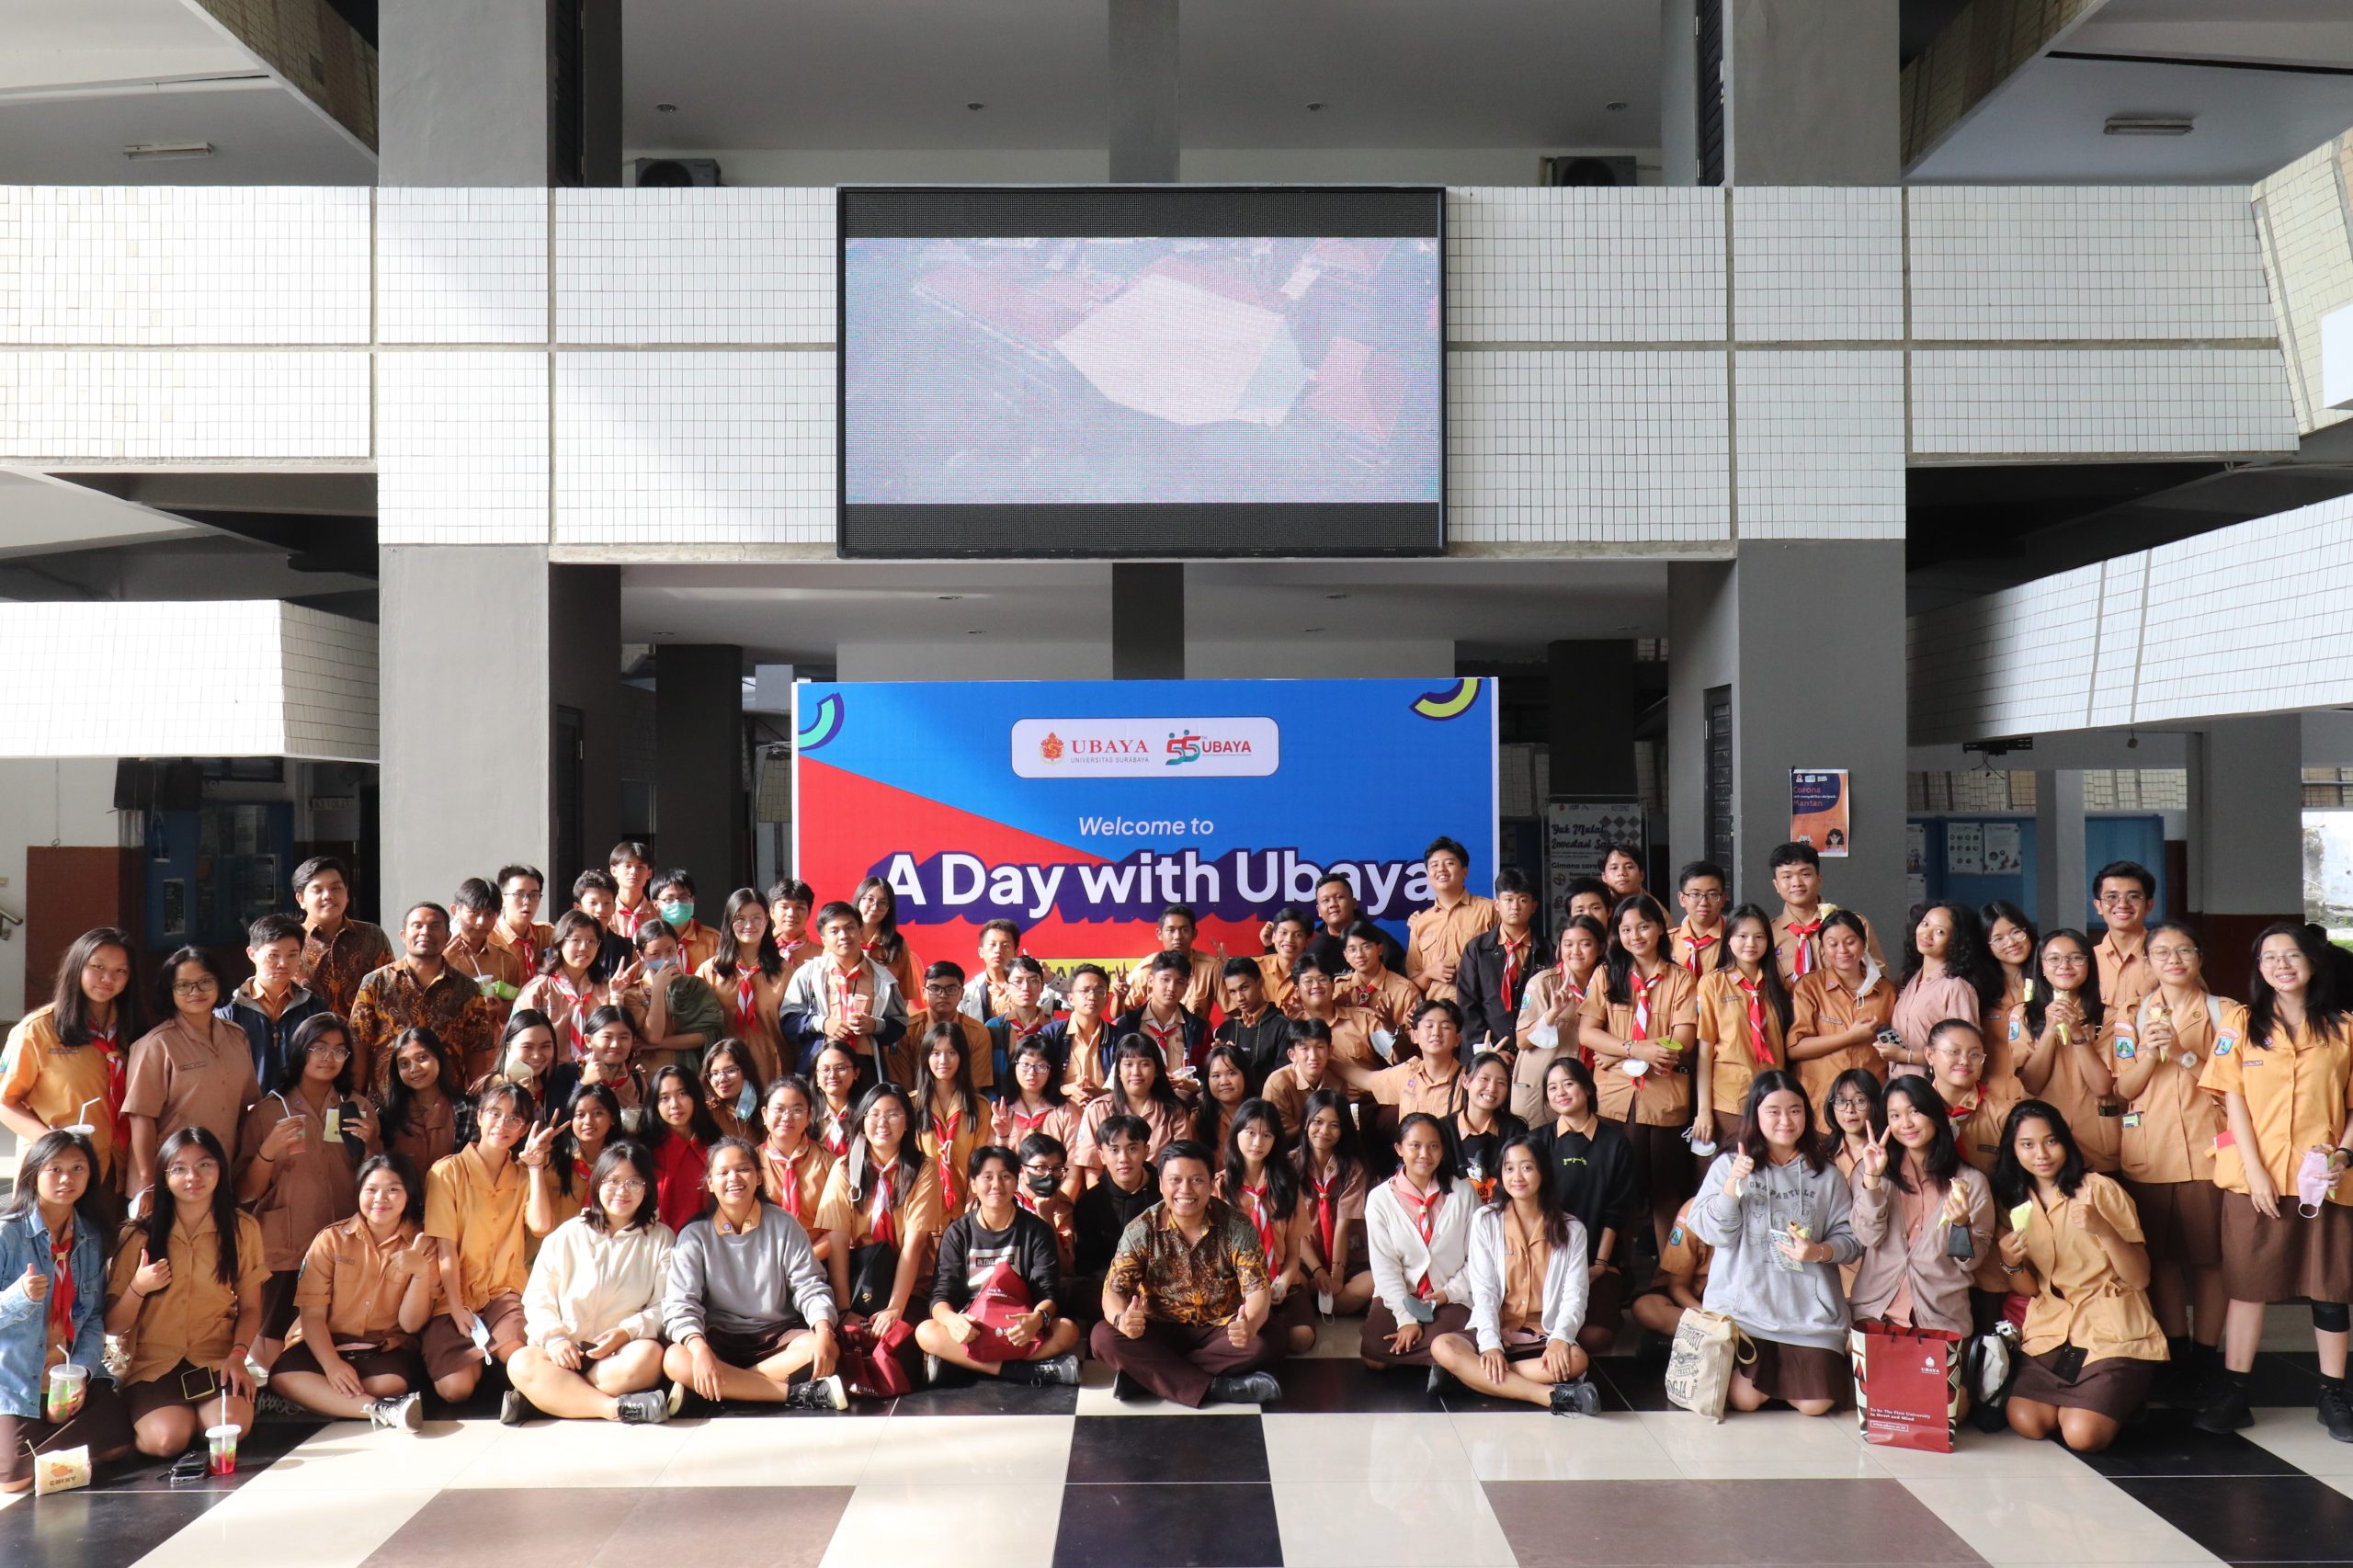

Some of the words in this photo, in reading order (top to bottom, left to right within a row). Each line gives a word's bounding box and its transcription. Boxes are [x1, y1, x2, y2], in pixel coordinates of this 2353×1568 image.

[1071, 739, 1149, 754] UBAYA
[1202, 740, 1252, 753] UBAYA
[1793, 786, 1821, 794] Corona
[1079, 816, 1185, 835] Welcome
[1190, 817, 1214, 835] to
[886, 854, 927, 905] A
[941, 854, 1065, 919] Day
[1078, 851, 1221, 903] with
